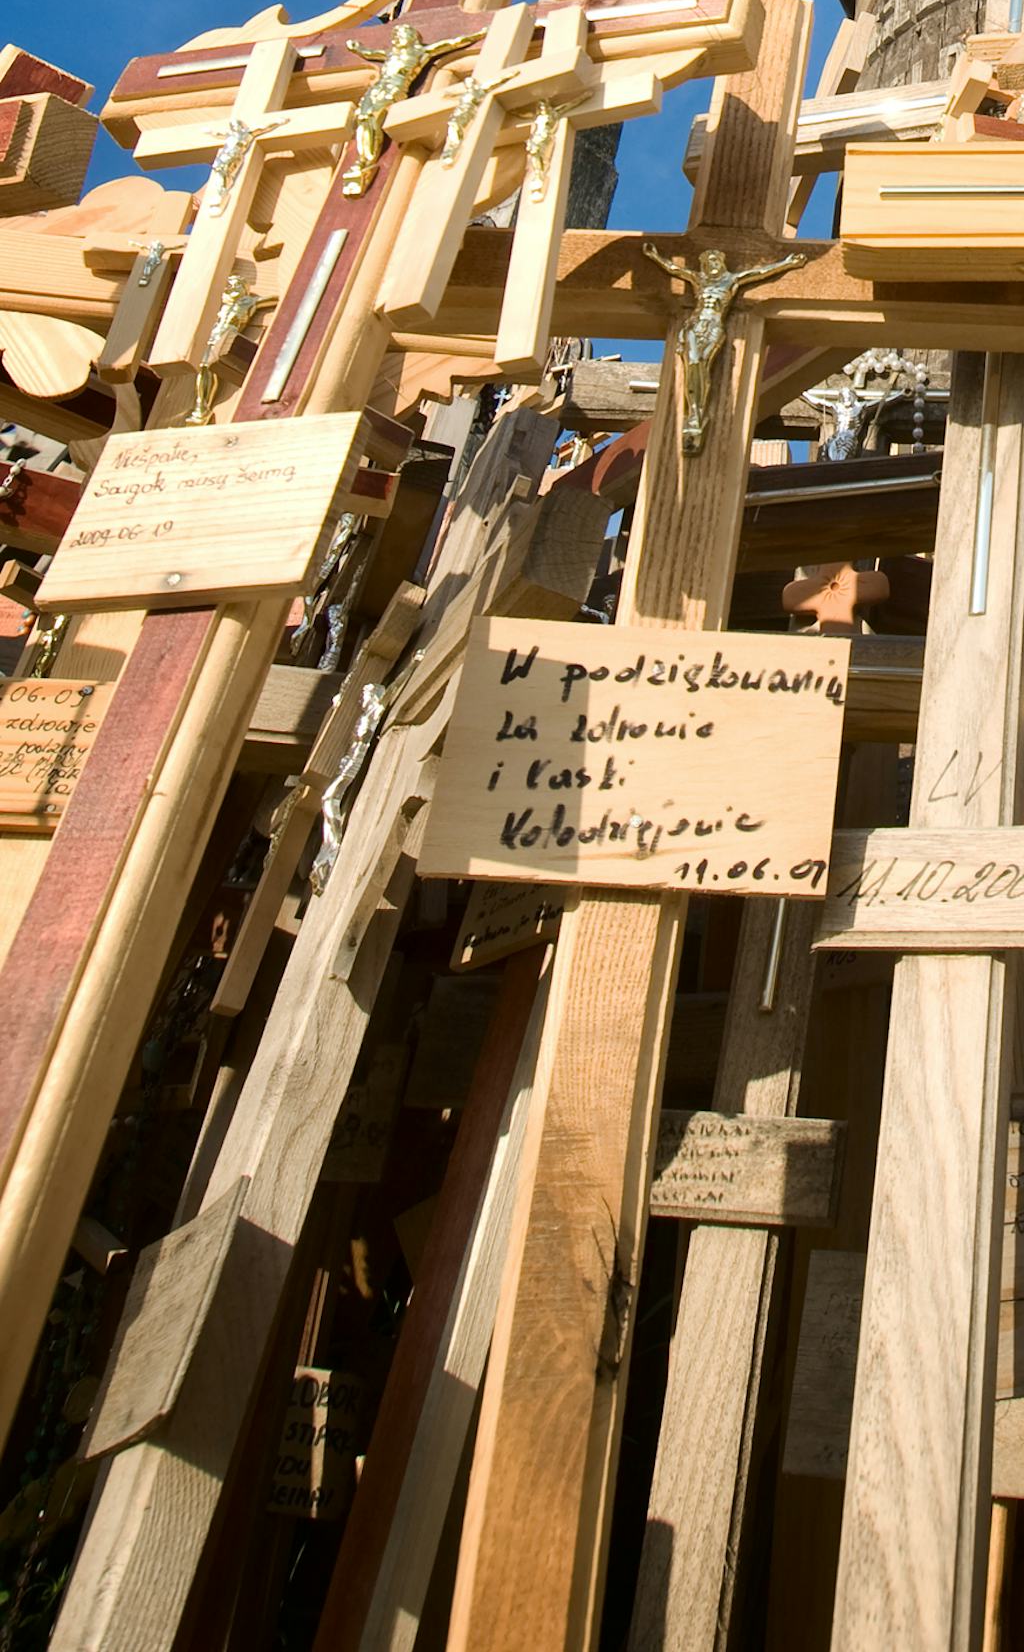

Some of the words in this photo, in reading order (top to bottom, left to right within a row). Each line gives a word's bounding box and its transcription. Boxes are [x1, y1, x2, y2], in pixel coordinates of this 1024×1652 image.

[500, 645, 541, 685] W
[5, 713, 97, 734] zdrowie
[487, 760, 505, 792] i
